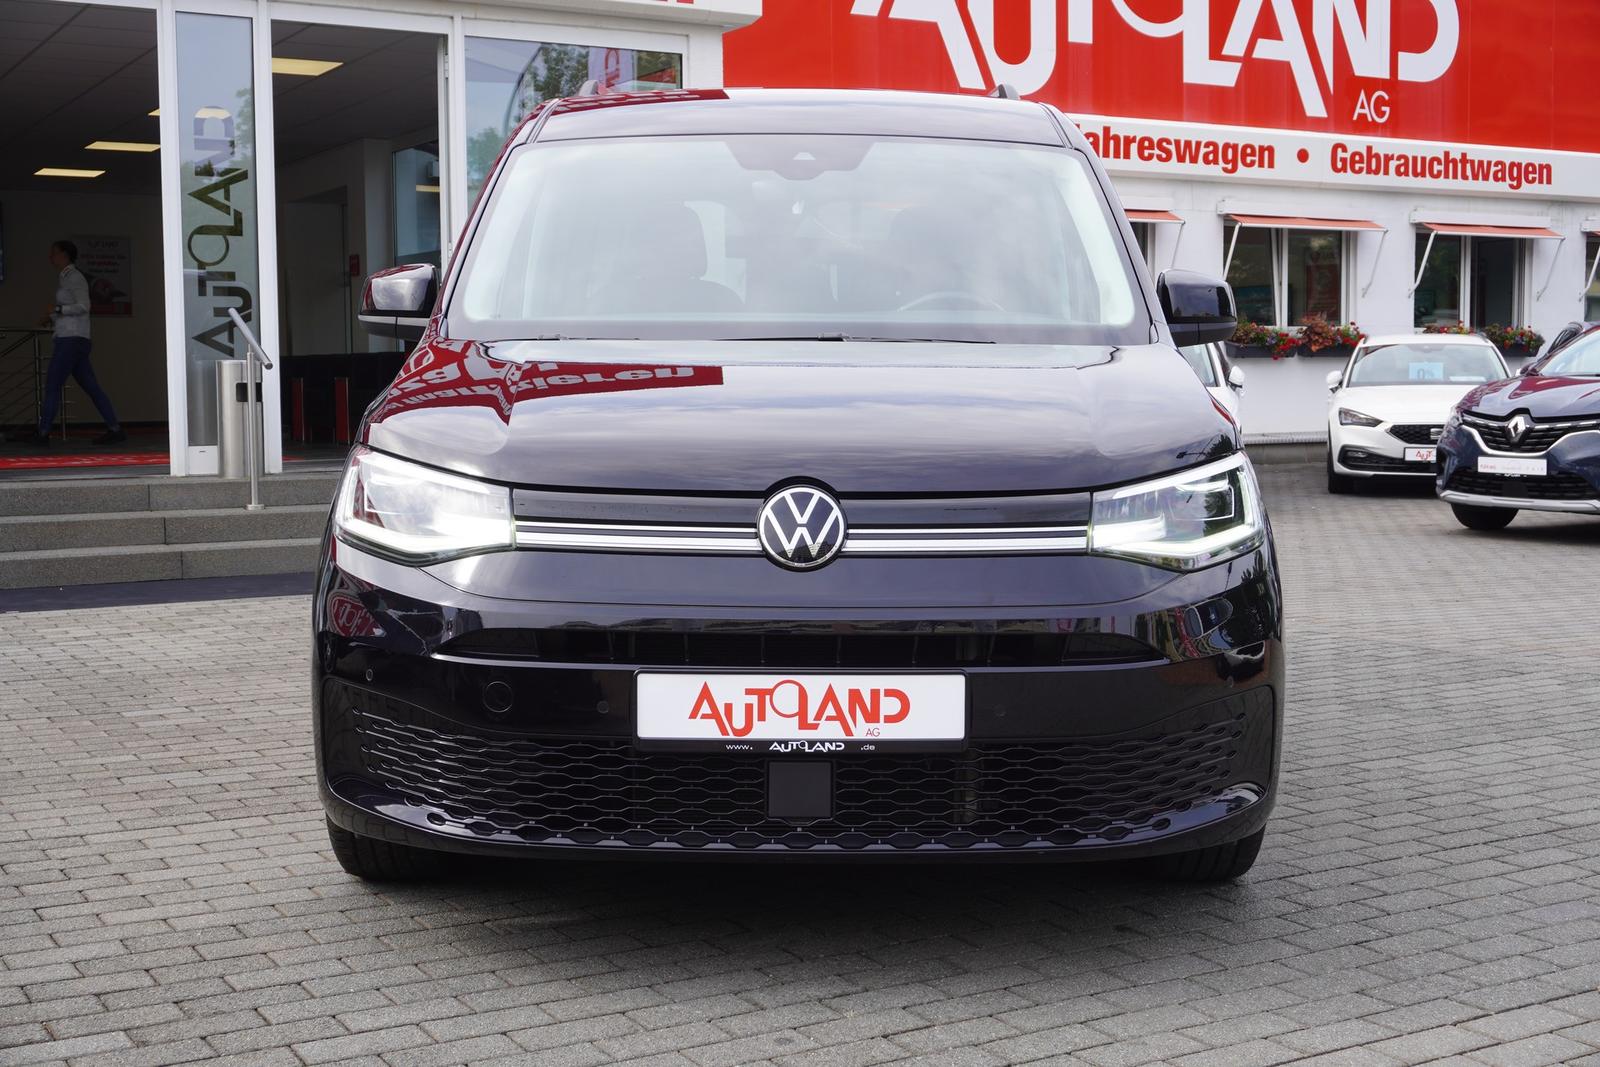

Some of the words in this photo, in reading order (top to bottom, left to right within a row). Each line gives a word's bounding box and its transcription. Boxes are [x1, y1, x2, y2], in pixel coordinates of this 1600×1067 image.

[1352, 89, 1391, 123] AG
[1075, 124, 1275, 174] ahreswagen
[1330, 142, 1552, 190] Gebrauchtwagen
[187, 106, 252, 358] AUTOLAND
[688, 679, 911, 737] AUTOLAND
[865, 727, 881, 737] AG
[769, 740, 845, 753] AUTOLAND
[860, 743, 876, 751] .de
